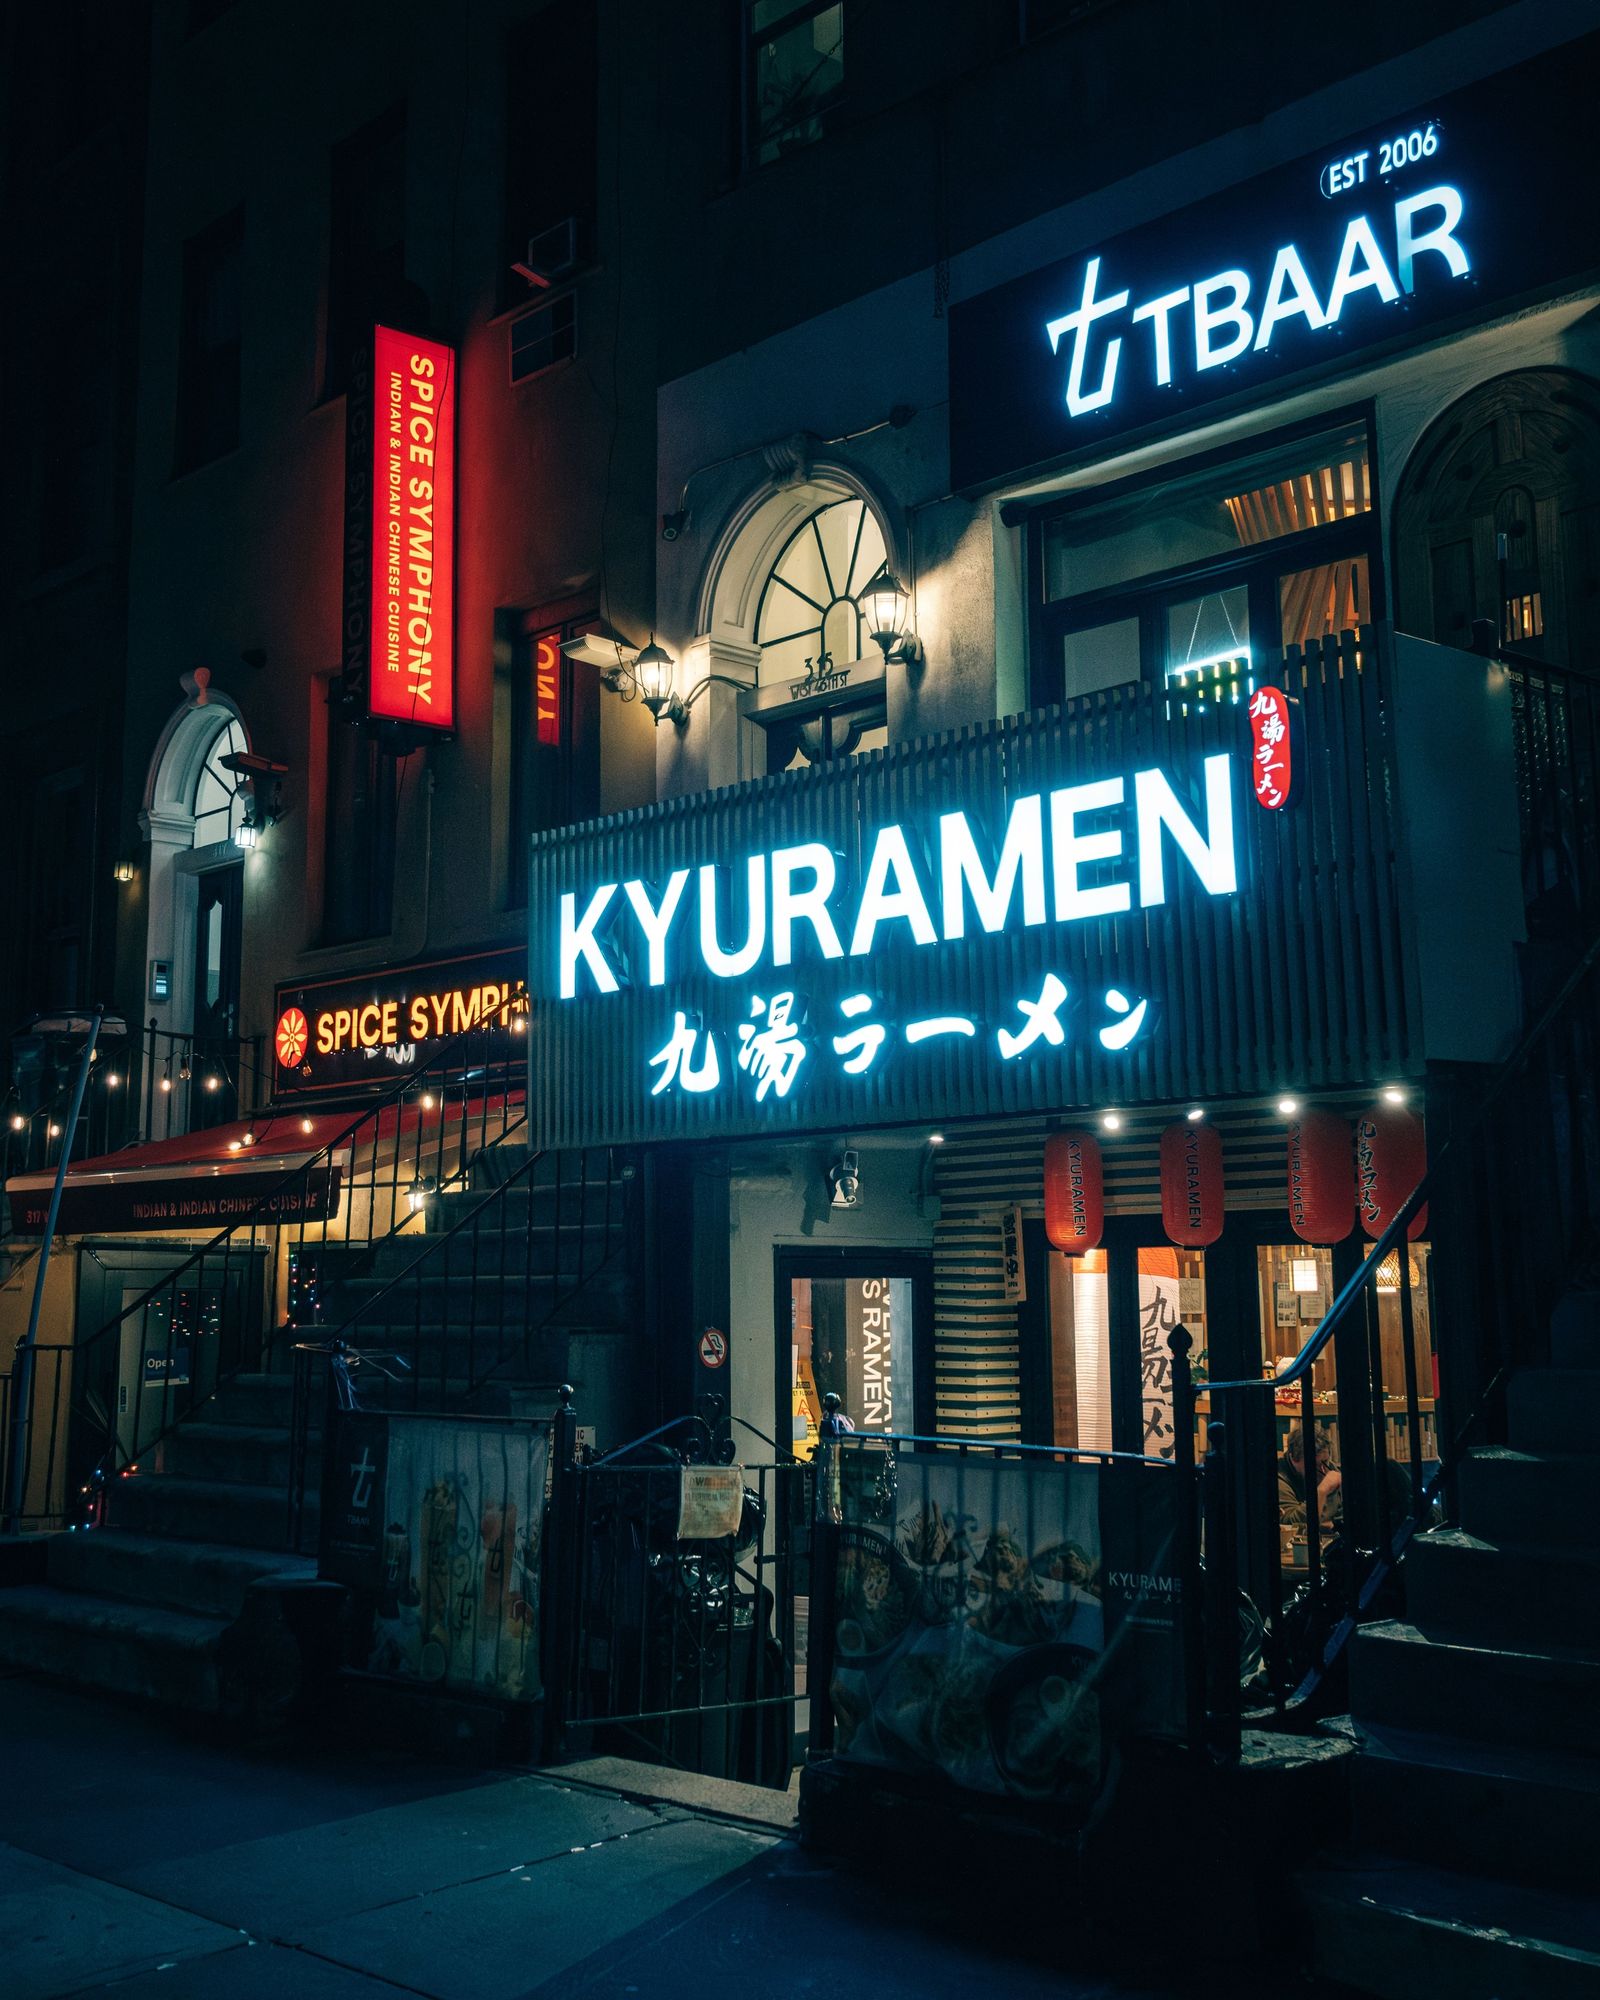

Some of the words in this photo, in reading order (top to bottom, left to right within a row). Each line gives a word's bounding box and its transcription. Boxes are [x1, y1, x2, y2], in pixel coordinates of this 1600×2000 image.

[1329, 152, 1368, 195] EST
[1379, 126, 1437, 175] 2006
[1132, 186, 1470, 387] TBAAR
[390, 371, 401, 433] INDIAN
[390, 437, 402, 449] &
[410, 354, 434, 467] SPICE
[389, 453, 401, 516] INDIAN
[388, 521, 401, 597] CHINESE
[407, 477, 434, 705] SYMPHONY
[387, 600, 400, 673] CUISINE
[1249, 691, 1286, 807] 九湯ラーメン
[559, 753, 1238, 1000] KYURAMEN
[316, 1001, 398, 1055] SPICE
[410, 980, 530, 1040] SYMPH
[132, 1202, 167, 1219] INDIAN
[169, 1203, 177, 1215] &
[179, 1199, 216, 1217] INDIAN
[1067, 1139, 1088, 1238] KYURAMEN
[1184, 1129, 1202, 1229] KYURAMEN
[863, 1307, 883, 1425] RAMEN
